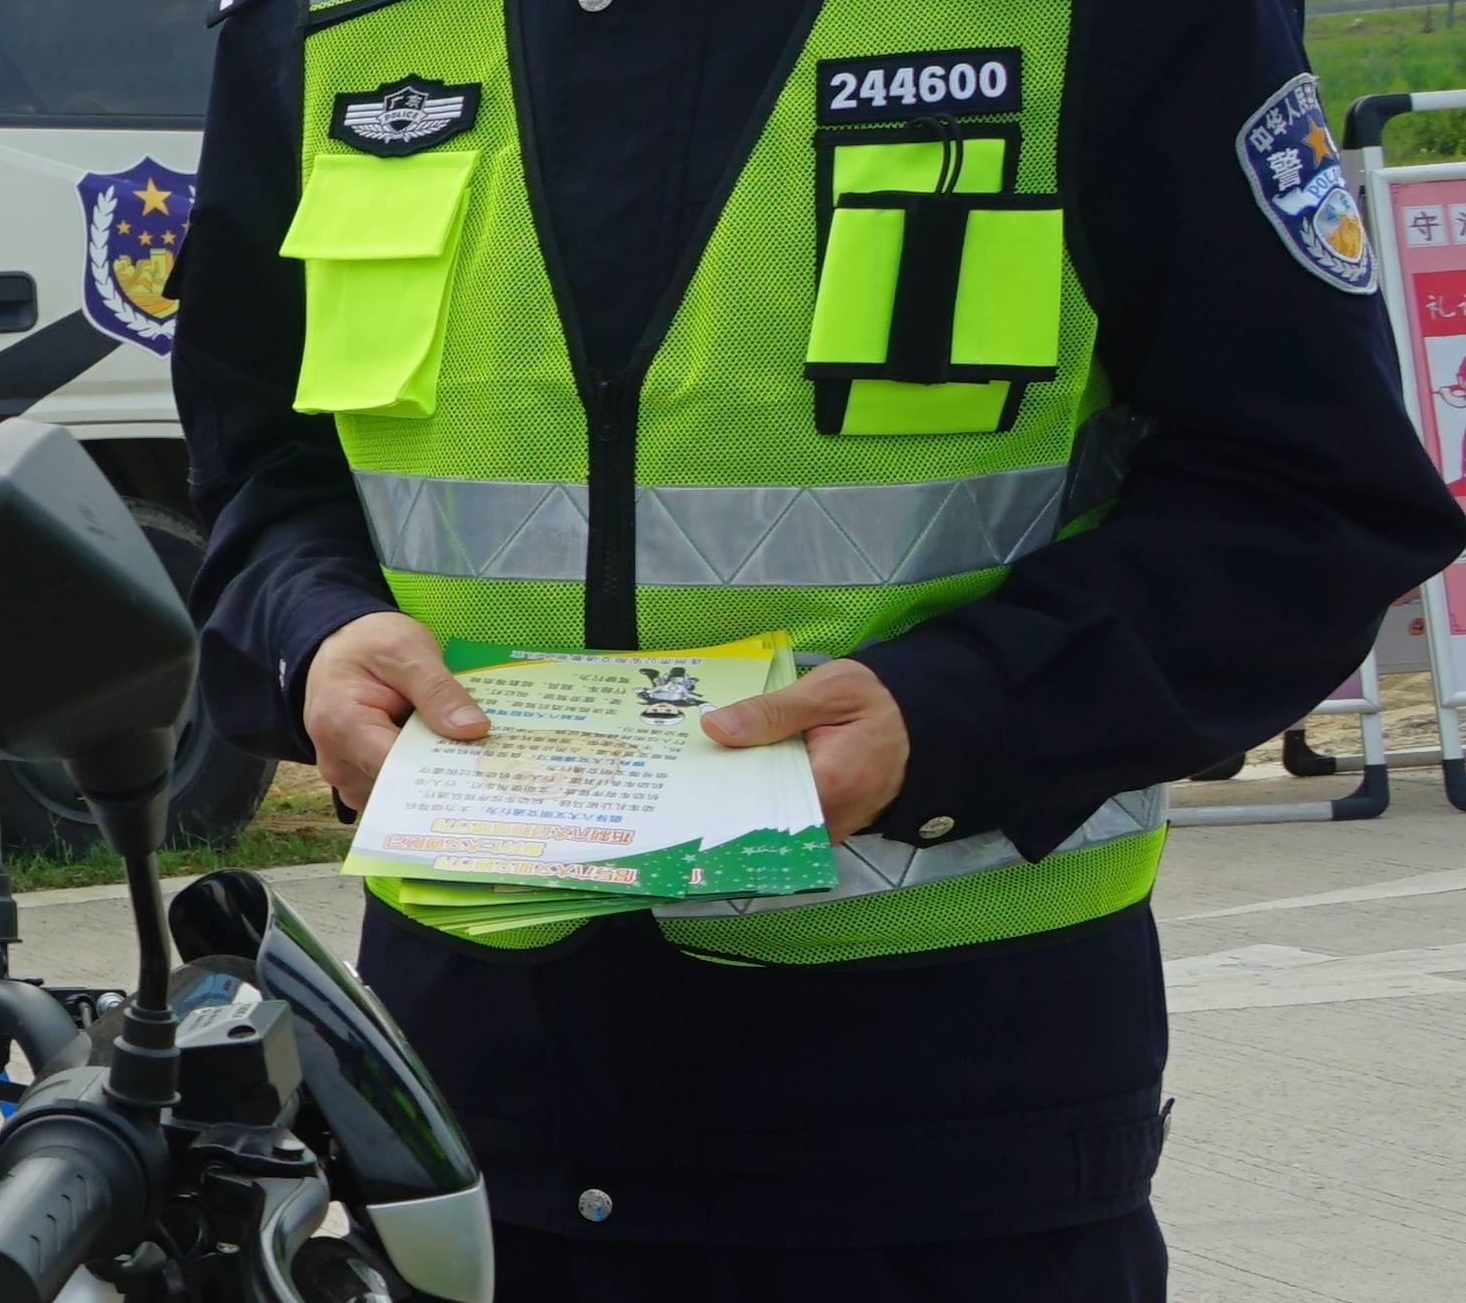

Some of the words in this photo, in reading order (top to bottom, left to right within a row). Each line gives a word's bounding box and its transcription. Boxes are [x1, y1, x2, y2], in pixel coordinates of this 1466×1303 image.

[829, 61, 1007, 110] 244600
[384, 110, 419, 121] POLICE
[1266, 148, 1303, 192] 警
